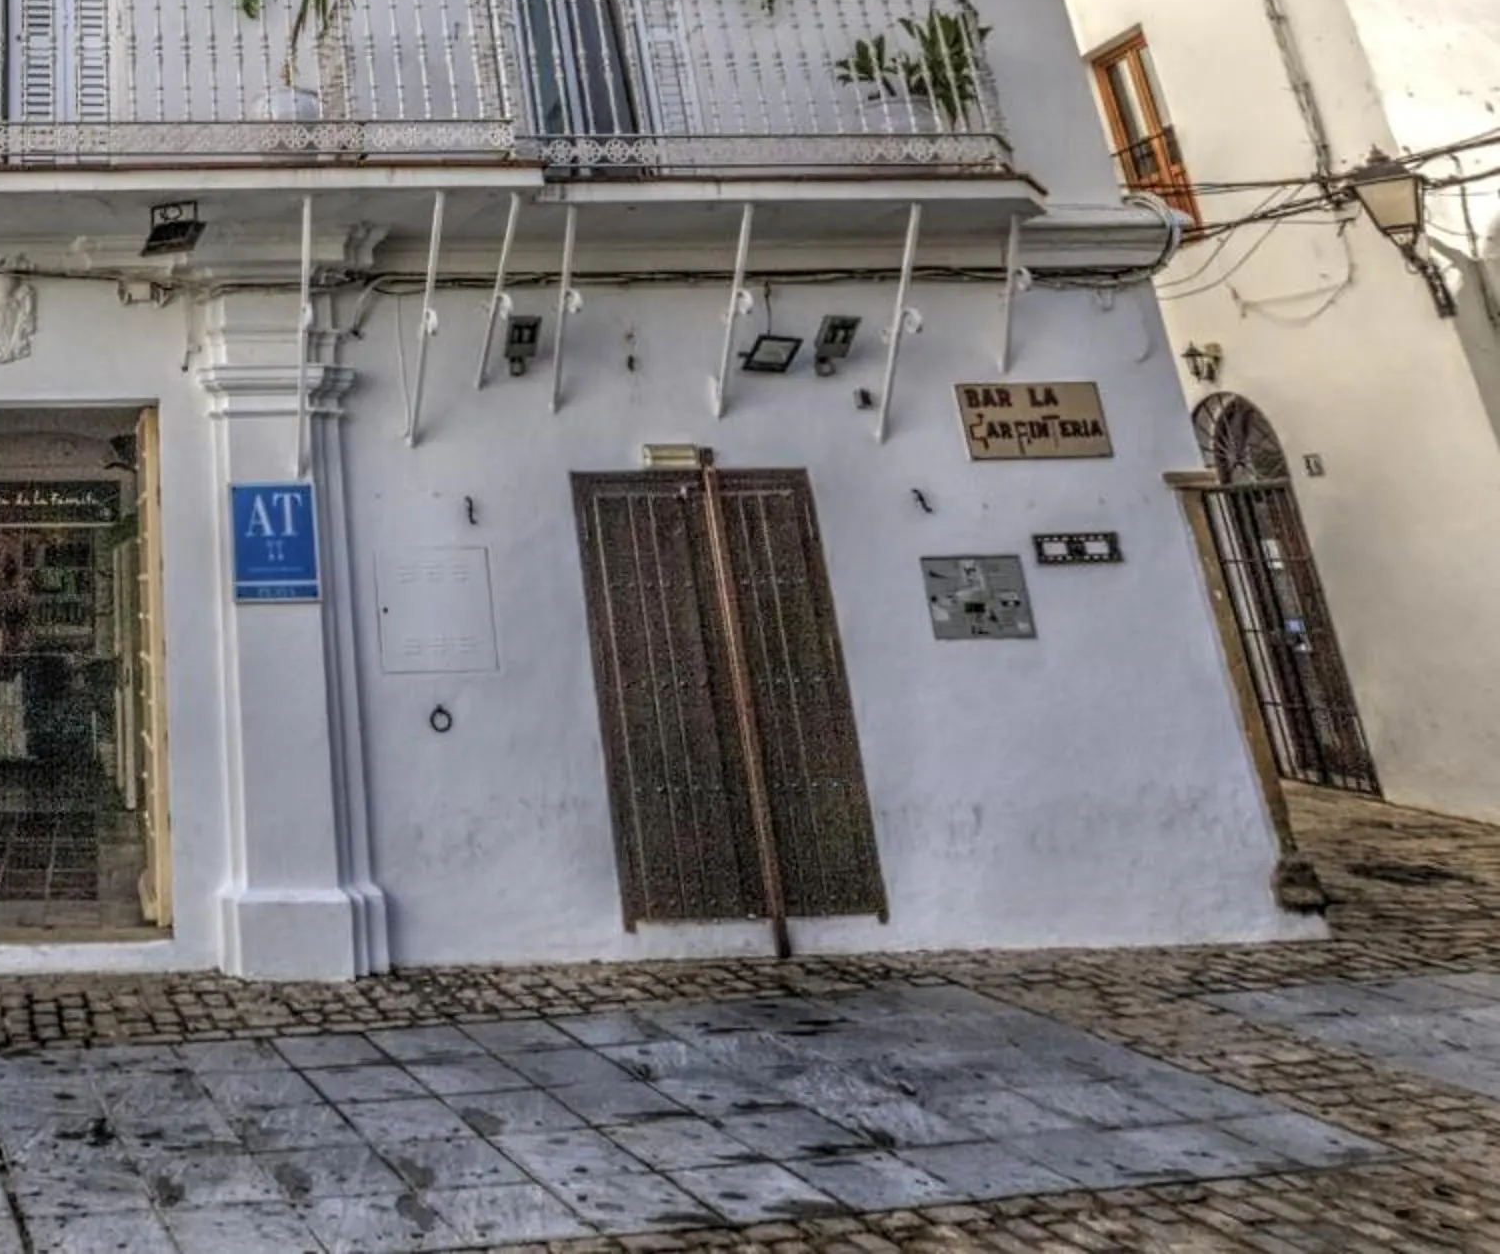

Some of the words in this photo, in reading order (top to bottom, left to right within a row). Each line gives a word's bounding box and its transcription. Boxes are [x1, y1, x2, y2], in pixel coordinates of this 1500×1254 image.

[964, 388, 1012, 408] BAR
[1028, 387, 1059, 407] LA
[244, 491, 303, 537] AT
